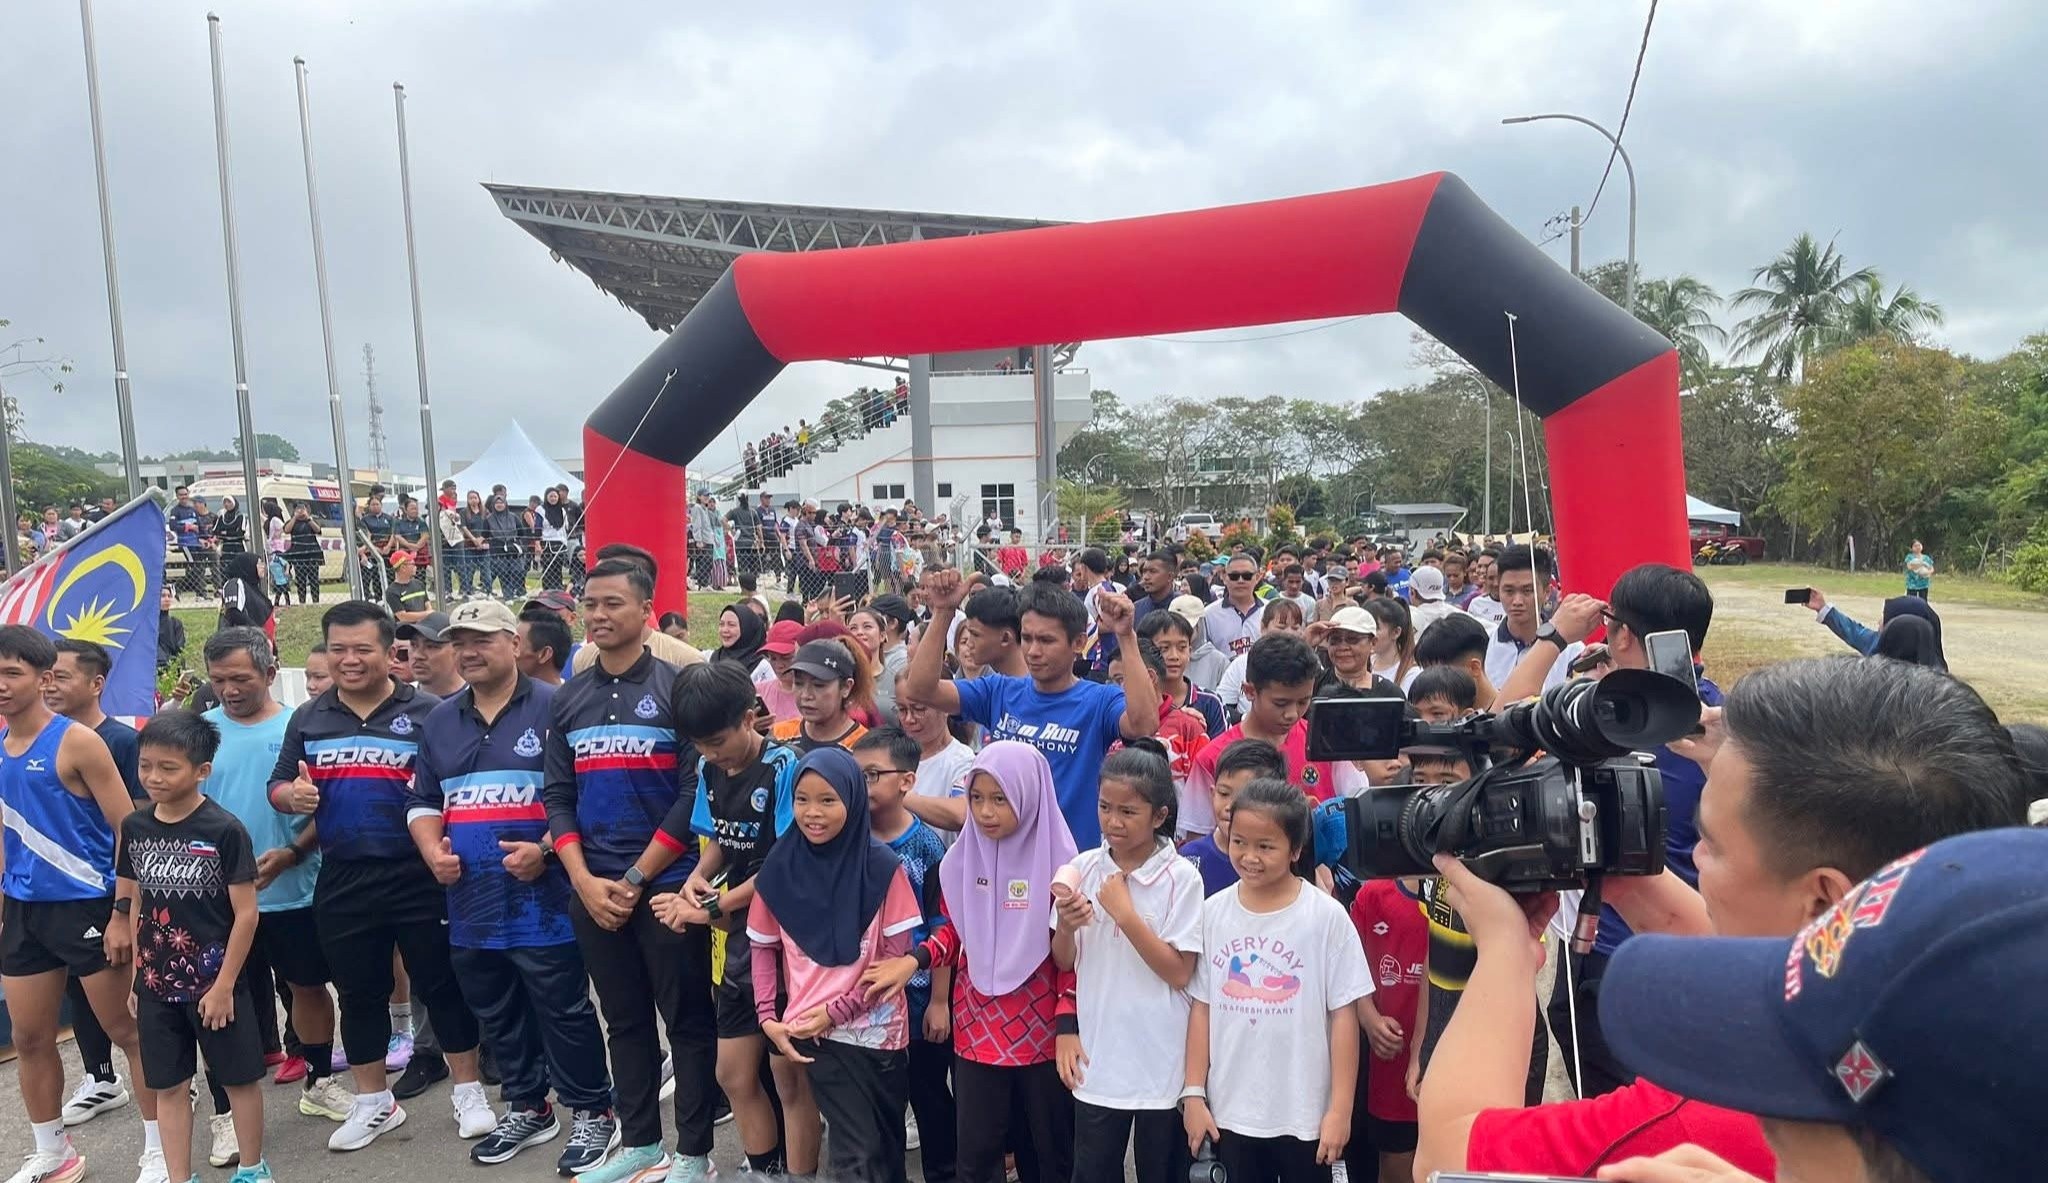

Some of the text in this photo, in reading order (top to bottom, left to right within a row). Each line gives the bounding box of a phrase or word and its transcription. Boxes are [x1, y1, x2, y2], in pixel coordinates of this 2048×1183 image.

[1039, 723, 1080, 743] Run
[316, 746, 412, 768] PDRM
[575, 735, 656, 757] PDRM
[140, 851, 204, 879] Sabah
[1212, 936, 1304, 970] EVERY DAY
[1406, 963, 1423, 974] JE
[1235, 1005, 1262, 1014] FRESH
[1264, 1007, 1294, 1015] START
